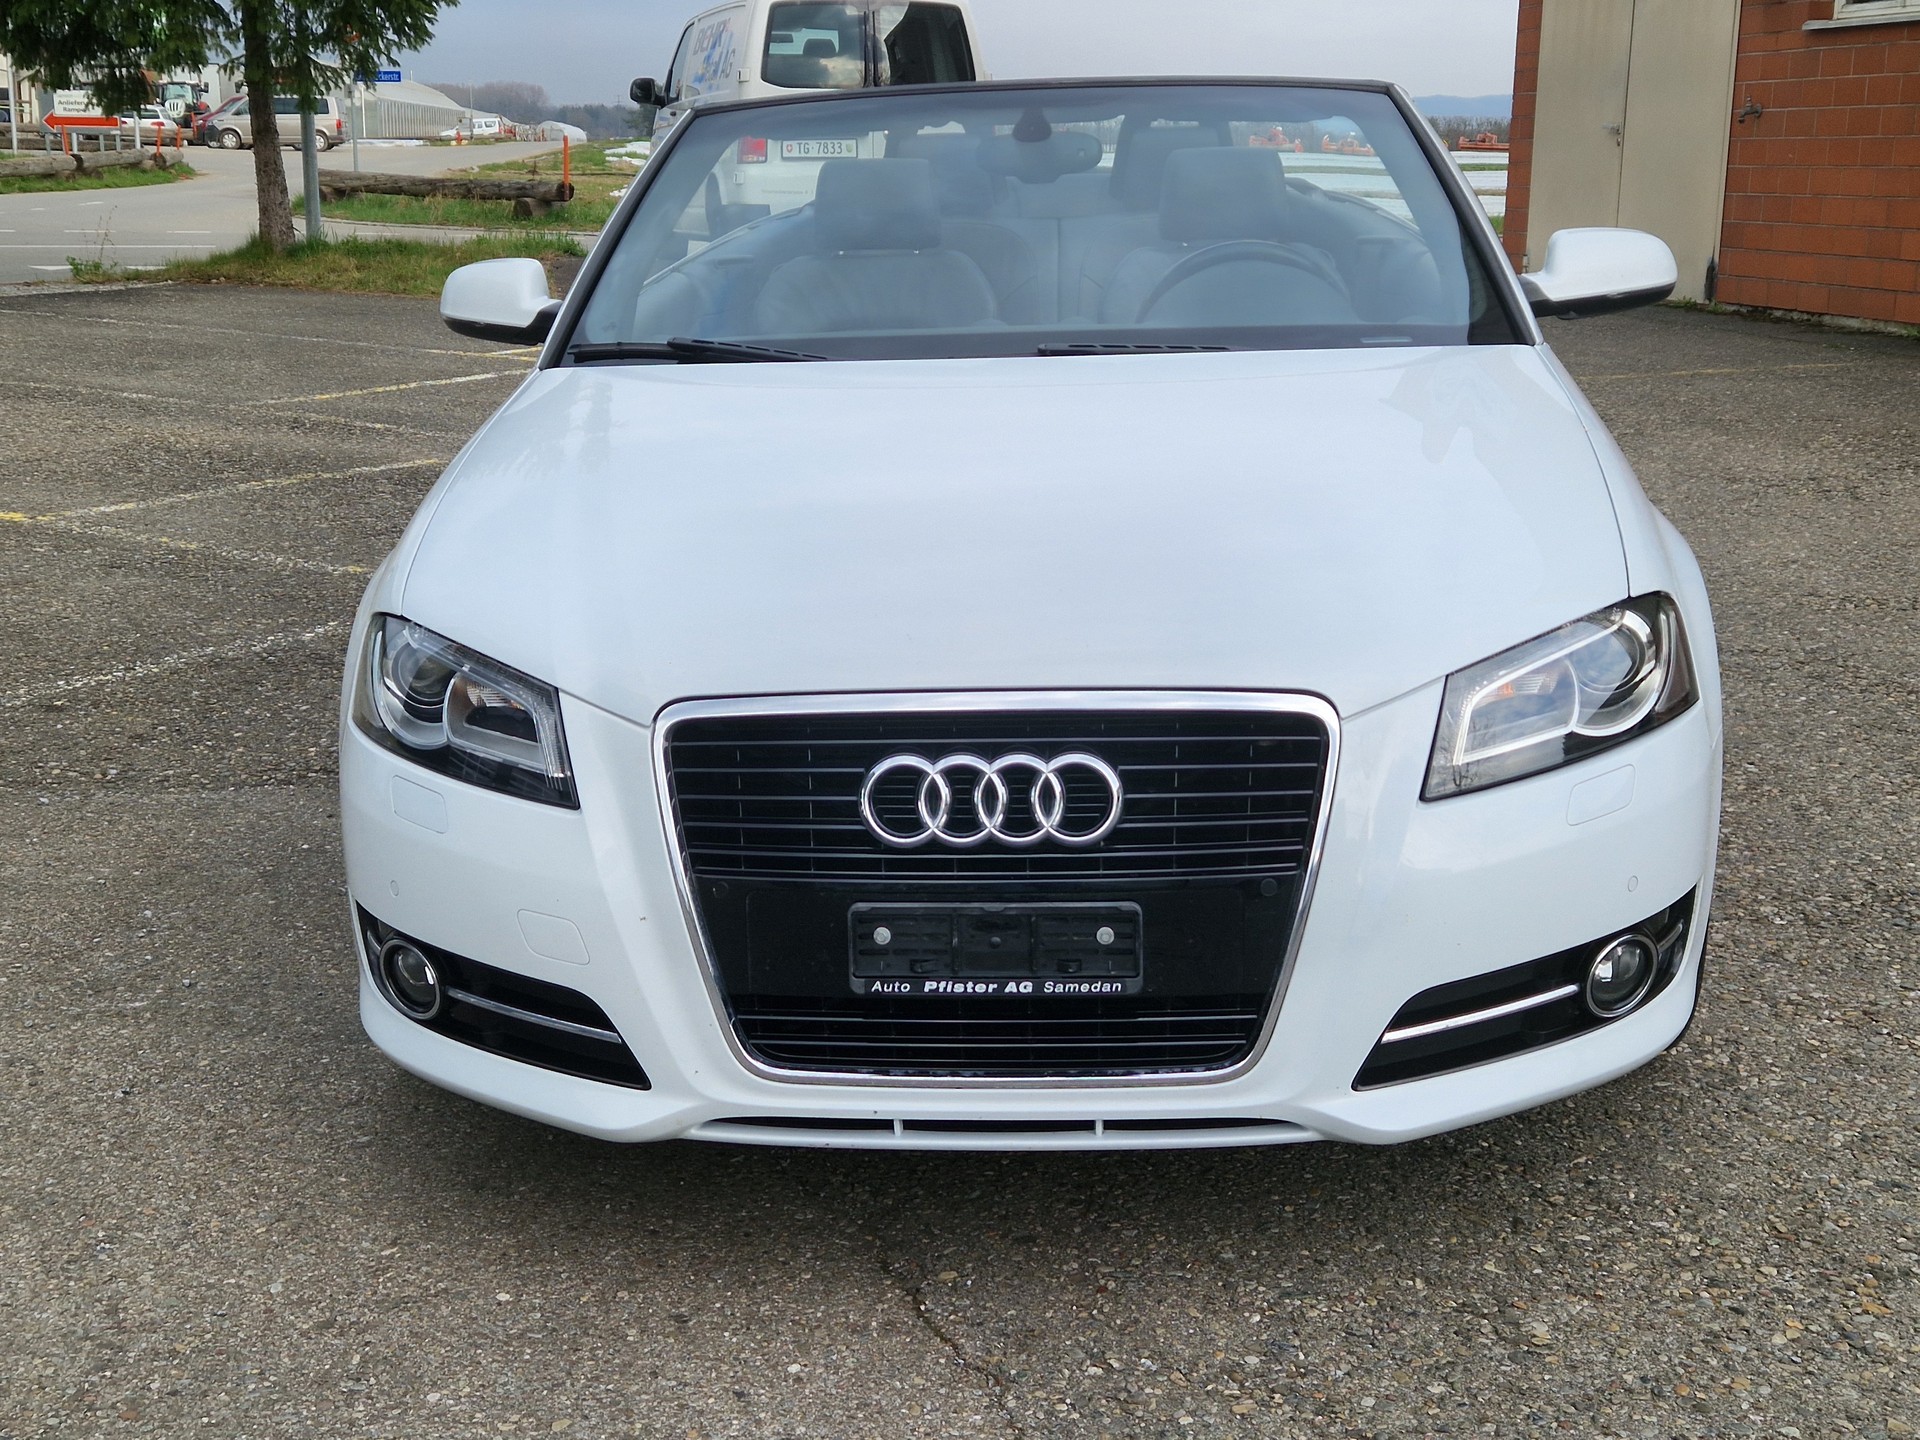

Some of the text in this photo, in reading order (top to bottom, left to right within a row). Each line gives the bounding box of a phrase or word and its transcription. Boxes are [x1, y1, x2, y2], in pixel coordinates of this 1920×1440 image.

[719, 49, 736, 79] AG
[871, 980, 1122, 993] Auto Pfister AG Samedan
